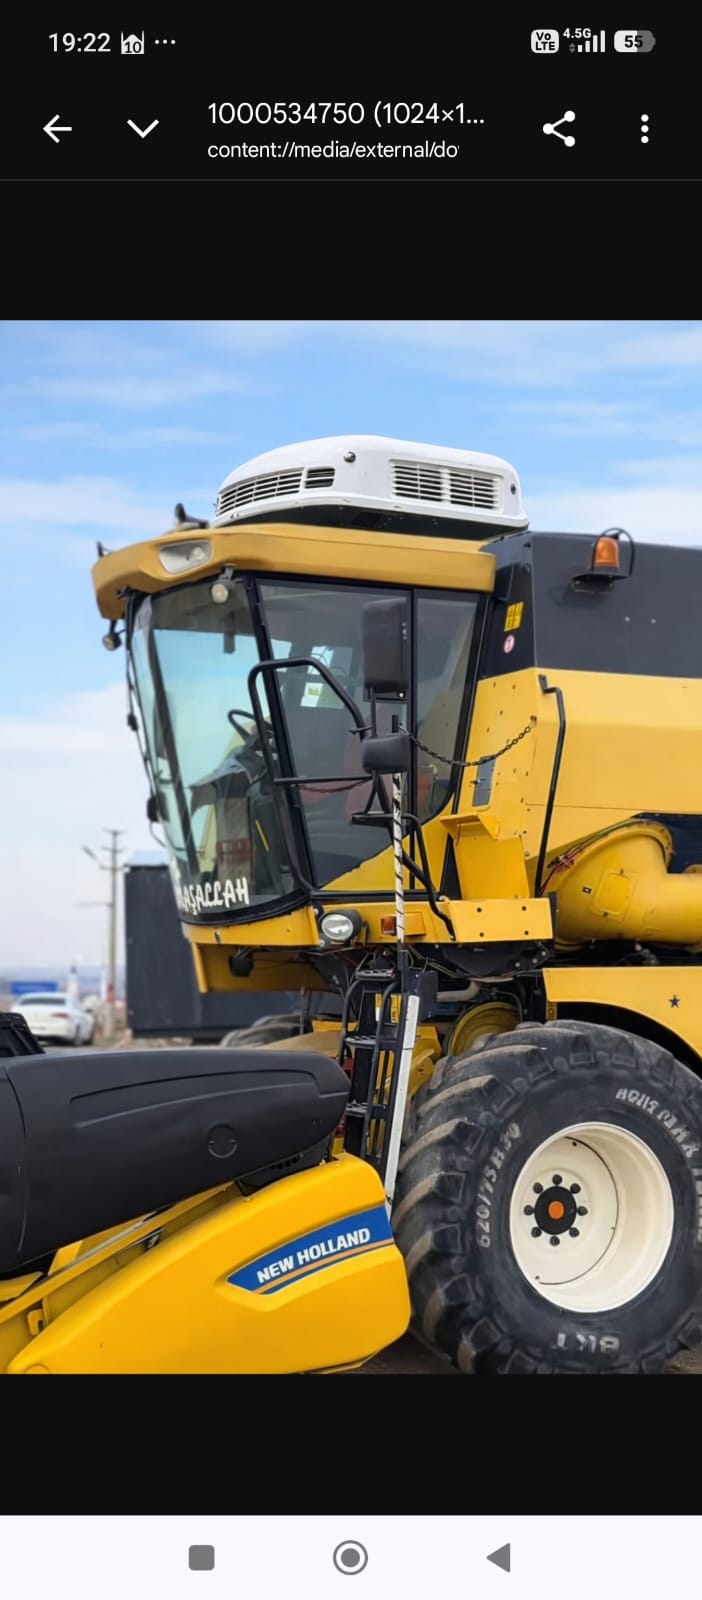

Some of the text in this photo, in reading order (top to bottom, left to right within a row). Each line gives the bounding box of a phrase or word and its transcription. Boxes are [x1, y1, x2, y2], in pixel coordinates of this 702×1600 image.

[535, 31, 553, 41] Vo
[562, 27, 592, 39] 4.5G
[48, 32, 112, 53] 19:22
[124, 41, 143, 54] 10
[535, 41, 556, 51] LTE
[624, 35, 644, 49] 55
[207, 102, 365, 125] 1000534750
[207, 140, 460, 158] content://media/external/do
[256, 1227, 371, 1284] NEW HOLLAND
